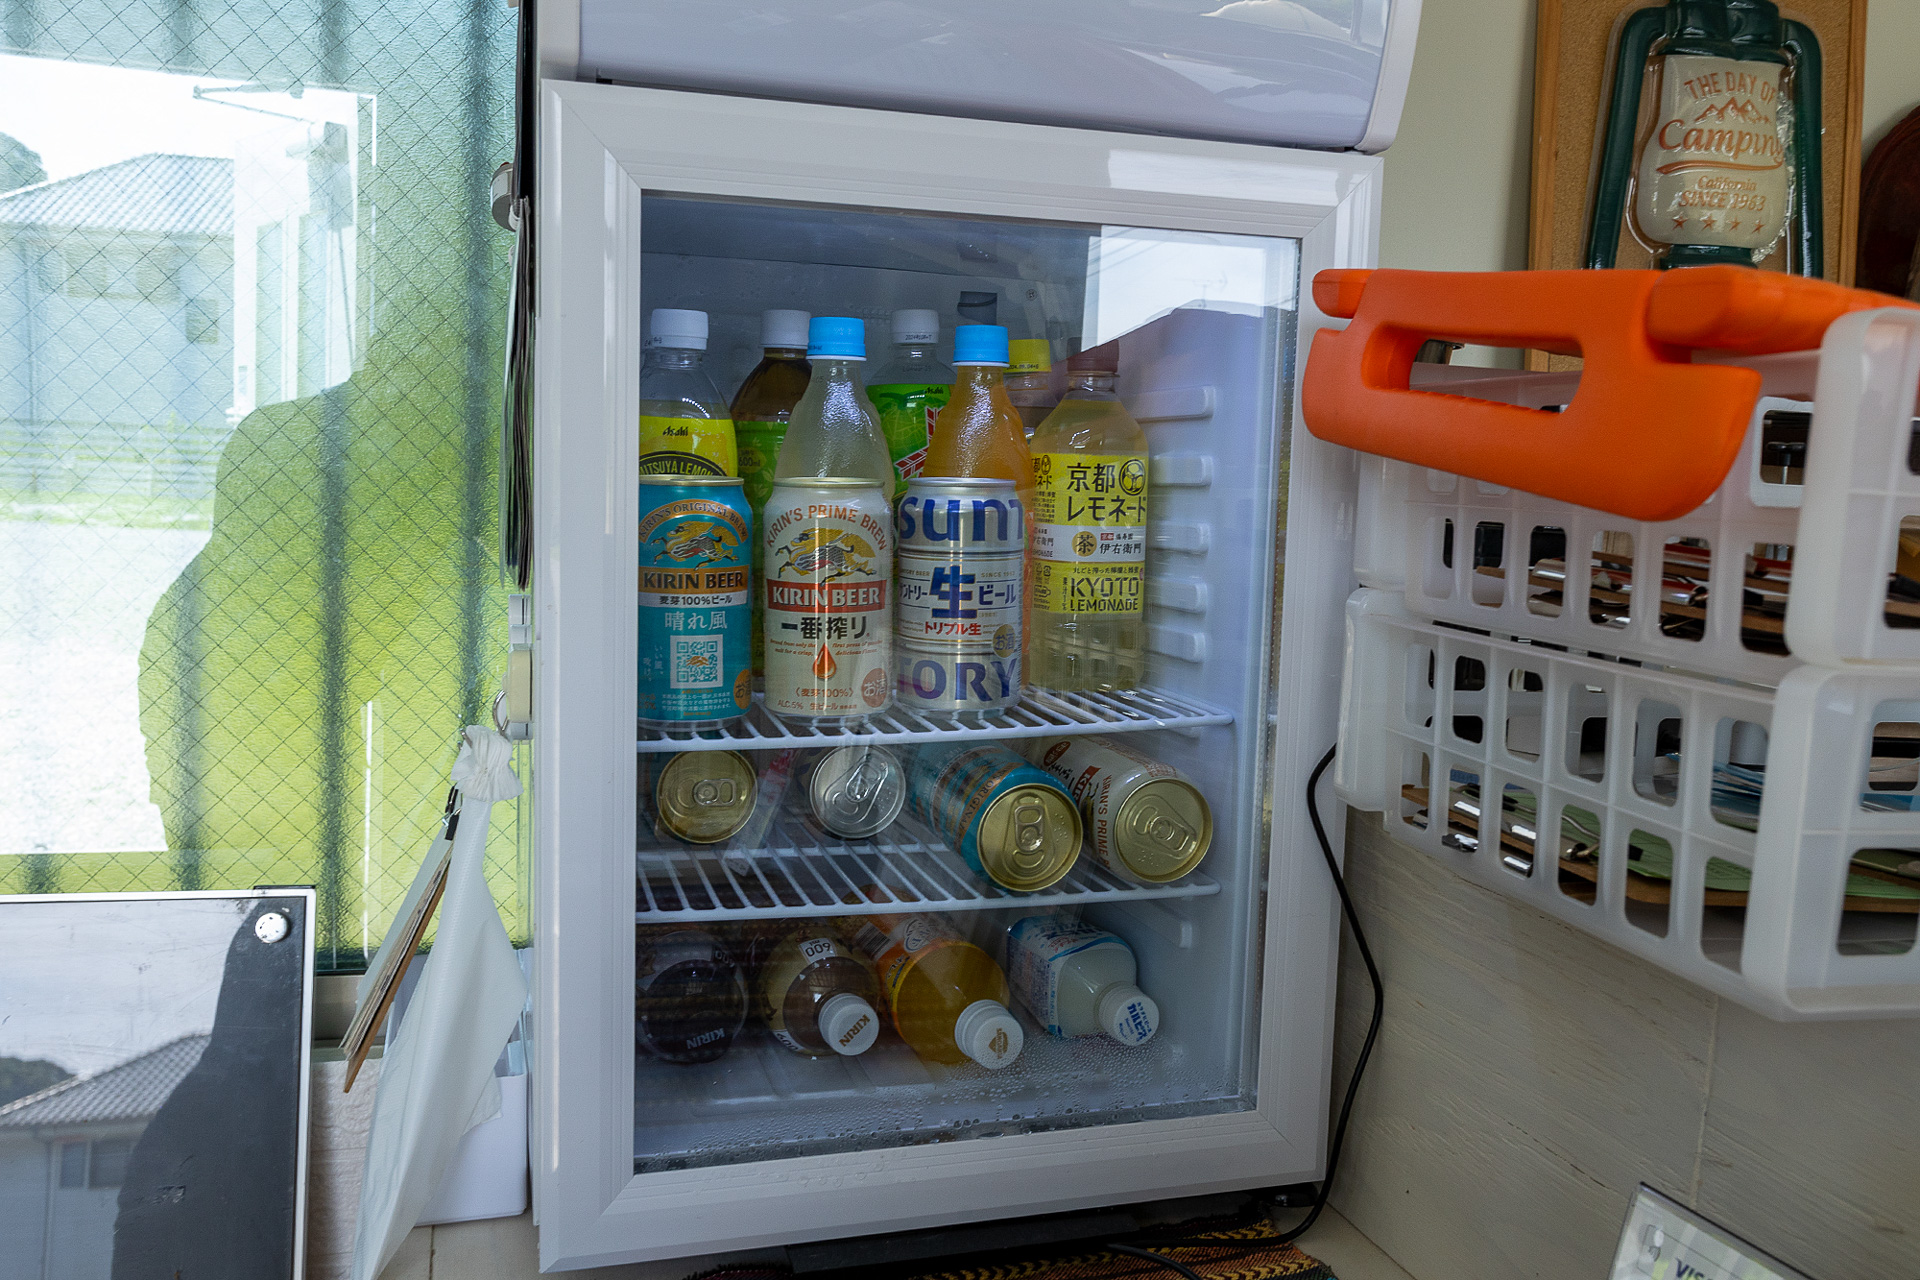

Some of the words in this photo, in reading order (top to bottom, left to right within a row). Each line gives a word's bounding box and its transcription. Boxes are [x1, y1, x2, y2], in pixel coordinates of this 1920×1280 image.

[1684, 72, 1721, 99] THE
[1725, 71, 1757, 95] DAY
[1658, 118, 1784, 162] Camping
[1678, 190, 1728, 208] SINCE
[662, 426, 689, 437] Asahi
[1067, 462, 1116, 494] 京都
[640, 506, 672, 538] KIRIN'S
[673, 502, 728, 517] ORIGINAL
[730, 511, 746, 538] BREW
[1067, 495, 1147, 523] レモネード
[766, 507, 803, 548] KIRIN'S
[808, 504, 858, 524] PRIME
[860, 513, 888, 551] BREW
[1076, 534, 1094, 554] 茶
[1099, 543, 1142, 555] 伊右衛門
[643, 571, 700, 590] KIRIN
[705, 570, 743, 589] BEER
[1070, 577, 1139, 598] KYOTO
[660, 594, 733, 606] 麦芽100%ビール
[772, 585, 829, 608] KIRIN
[831, 586, 880, 608] BEER
[979, 583, 1016, 606] ビール
[1070, 598, 1139, 612] LEMONADE
[664, 611, 728, 631] 晴れ風
[781, 615, 867, 640] 一番搾り
[925, 621, 982, 636] トリプル生
[1098, 774, 1113, 815] KIRIN'S
[1097, 819, 1109, 857] PRIME
[804, 942, 832, 958] 600
[686, 1028, 726, 1050] KIRIN
[838, 1013, 872, 1048] KIRIN
[1674, 1256, 1714, 1280] VI
